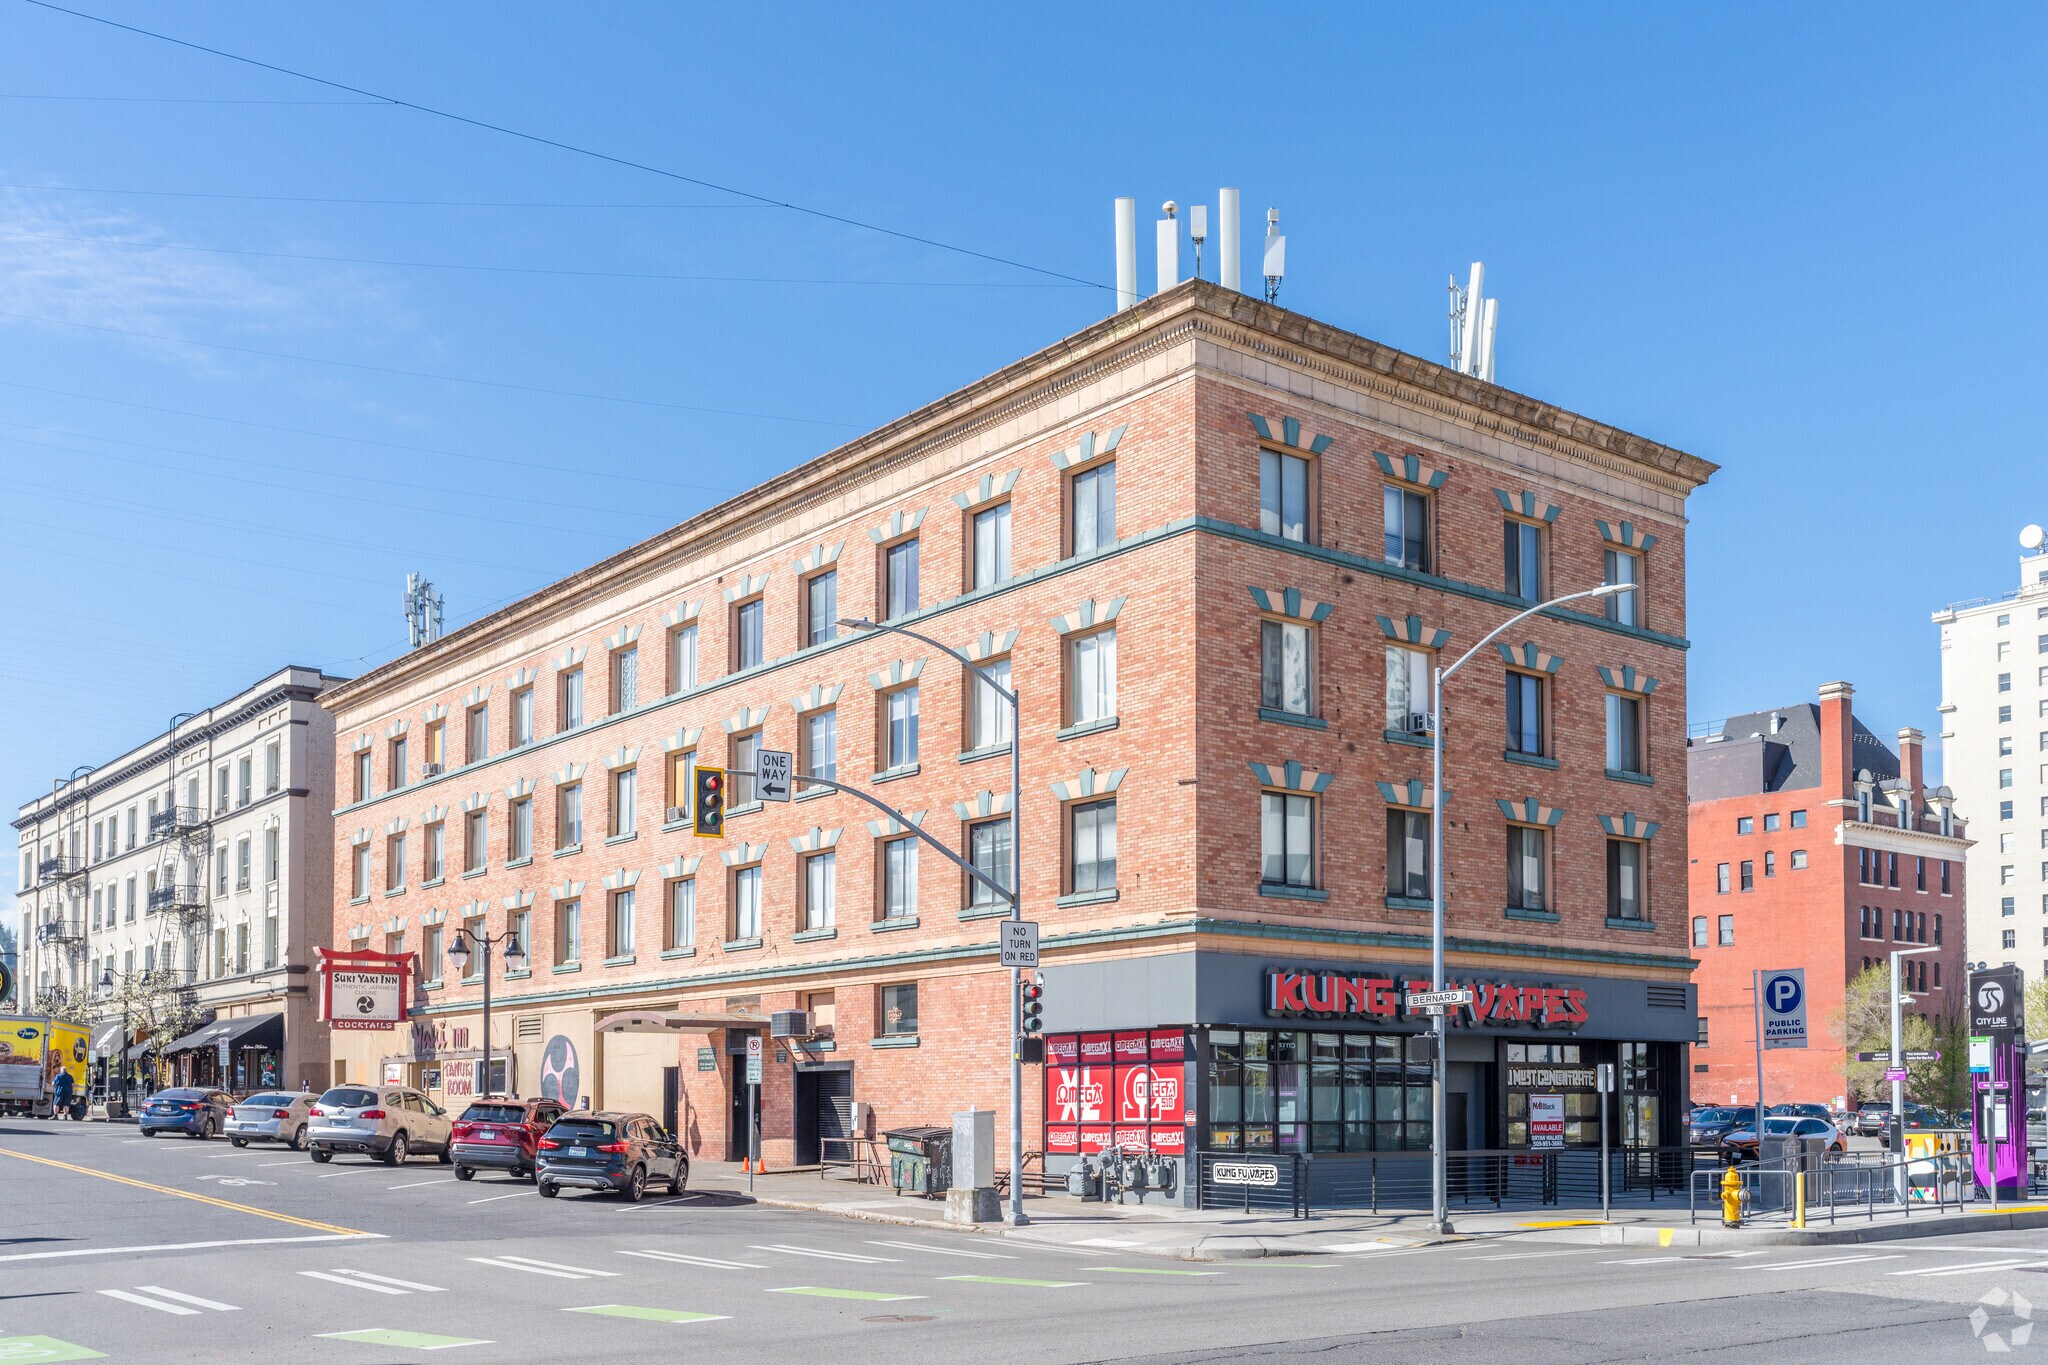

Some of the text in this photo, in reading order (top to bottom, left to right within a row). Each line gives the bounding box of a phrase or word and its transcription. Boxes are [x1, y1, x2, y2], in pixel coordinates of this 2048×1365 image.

[763, 755, 786, 767] ONE
[762, 768, 786, 780] WAY
[1013, 927, 1026, 936] NO
[1009, 939, 1031, 949] TURN
[1005, 952, 1036, 962] ON RED
[1272, 973, 1395, 1017] KUNG
[1463, 983, 1589, 1023] VAPES
[1412, 993, 1458, 1005] BERNARD
[1774, 980, 1796, 1010] P
[337, 1021, 392, 1029] COCKTAILS
[1768, 1019, 1801, 1027] PUBLIC
[1976, 1016, 2008, 1025] CITY LINE
[1766, 1027, 1805, 1036] PARKING
[1513, 1069, 1537, 1086] MUST
[447, 1079, 472, 1097] ROOM
[1533, 1124, 1562, 1132] AVAILABLE
[1216, 1167, 1275, 1180] KUNG FU VAPES
